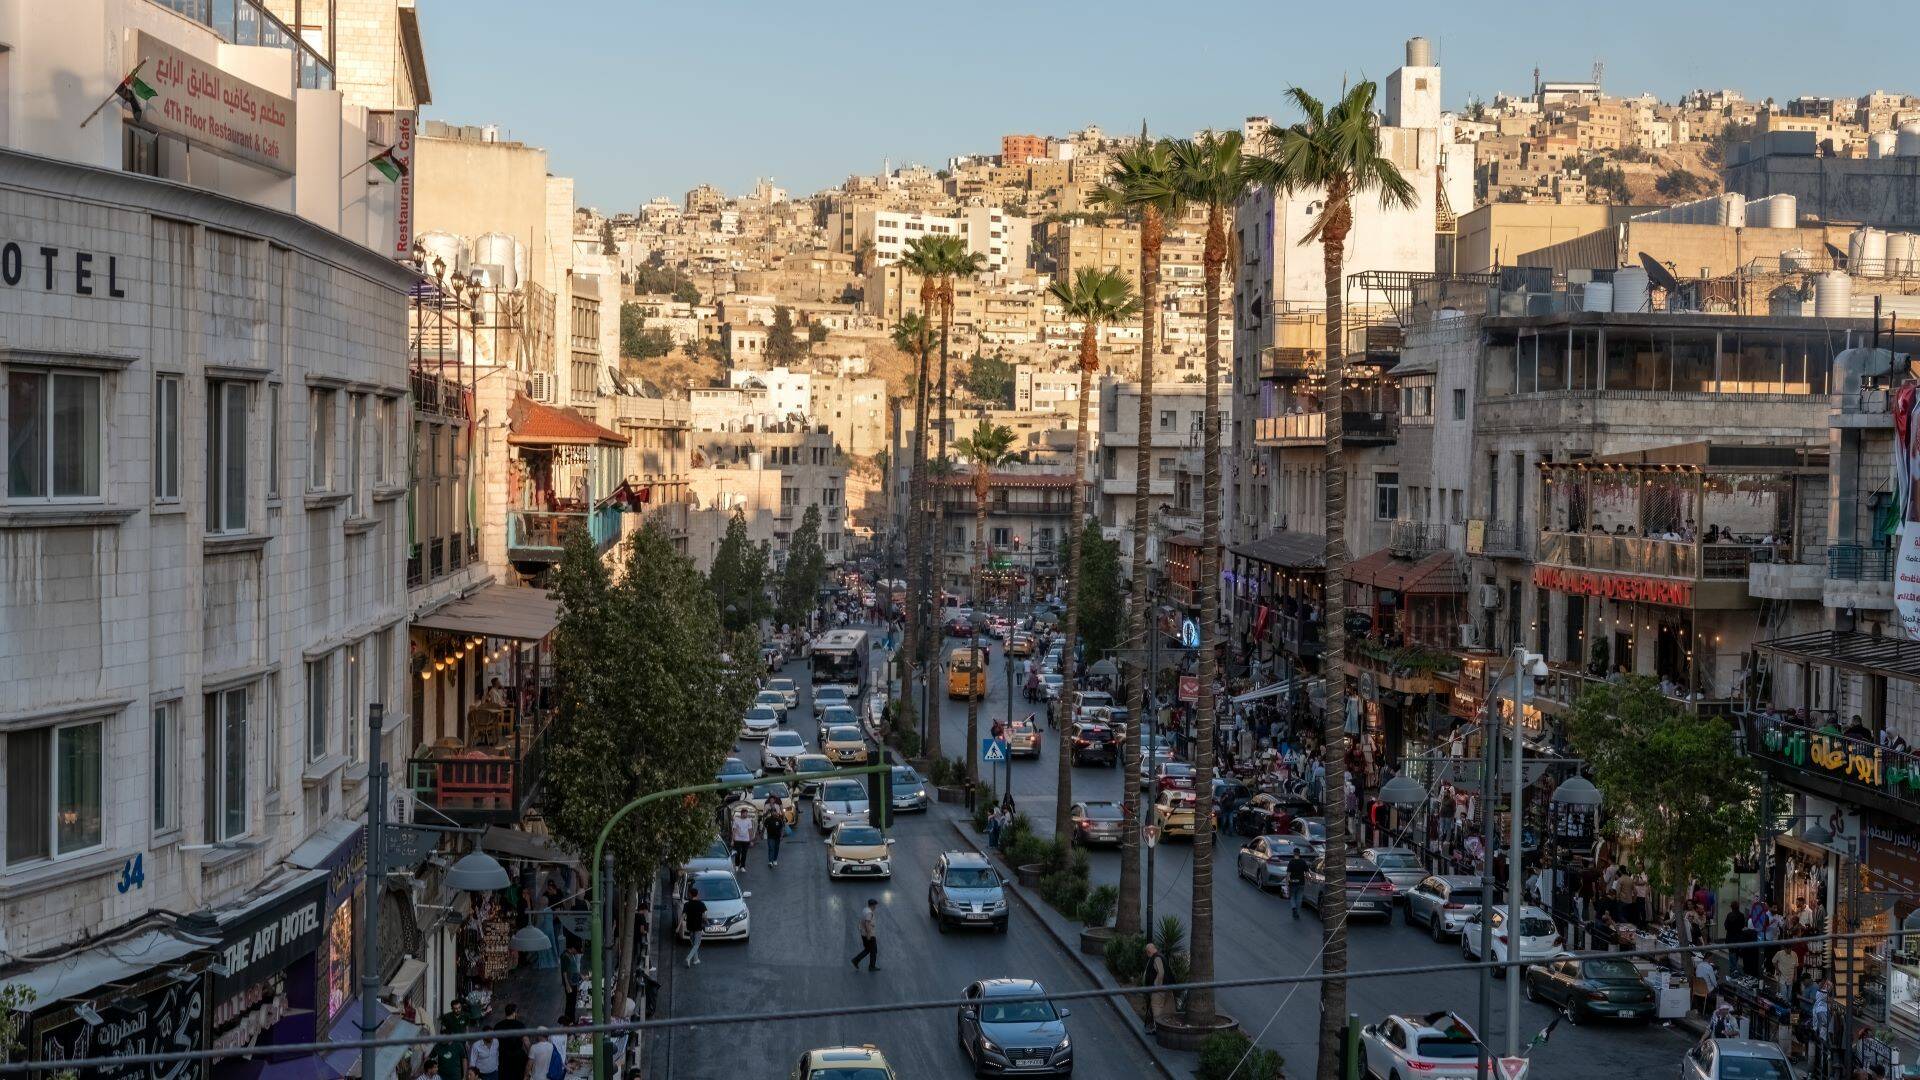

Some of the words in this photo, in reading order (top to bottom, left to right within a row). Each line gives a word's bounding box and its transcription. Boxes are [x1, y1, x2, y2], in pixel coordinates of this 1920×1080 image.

[155, 56, 184, 88] الرابع
[187, 67, 220, 101] الطابق
[223, 87, 256, 121] وكافيه
[259, 102, 286, 127] مطعم
[163, 98, 182, 122] 4Th
[184, 105, 207, 132] Floor
[209, 115, 253, 151] Restaurant
[255, 134, 261, 152] &
[263, 136, 280, 159] Café
[399, 117, 410, 150] Café
[397, 167, 409, 252] Restauran
[1616, 575, 1693, 608] RESTAURANT
[116, 852, 145, 895] 34
[223, 936, 251, 979] THE
[251, 921, 279, 963] ART
[280, 901, 320, 946] HOTEL
